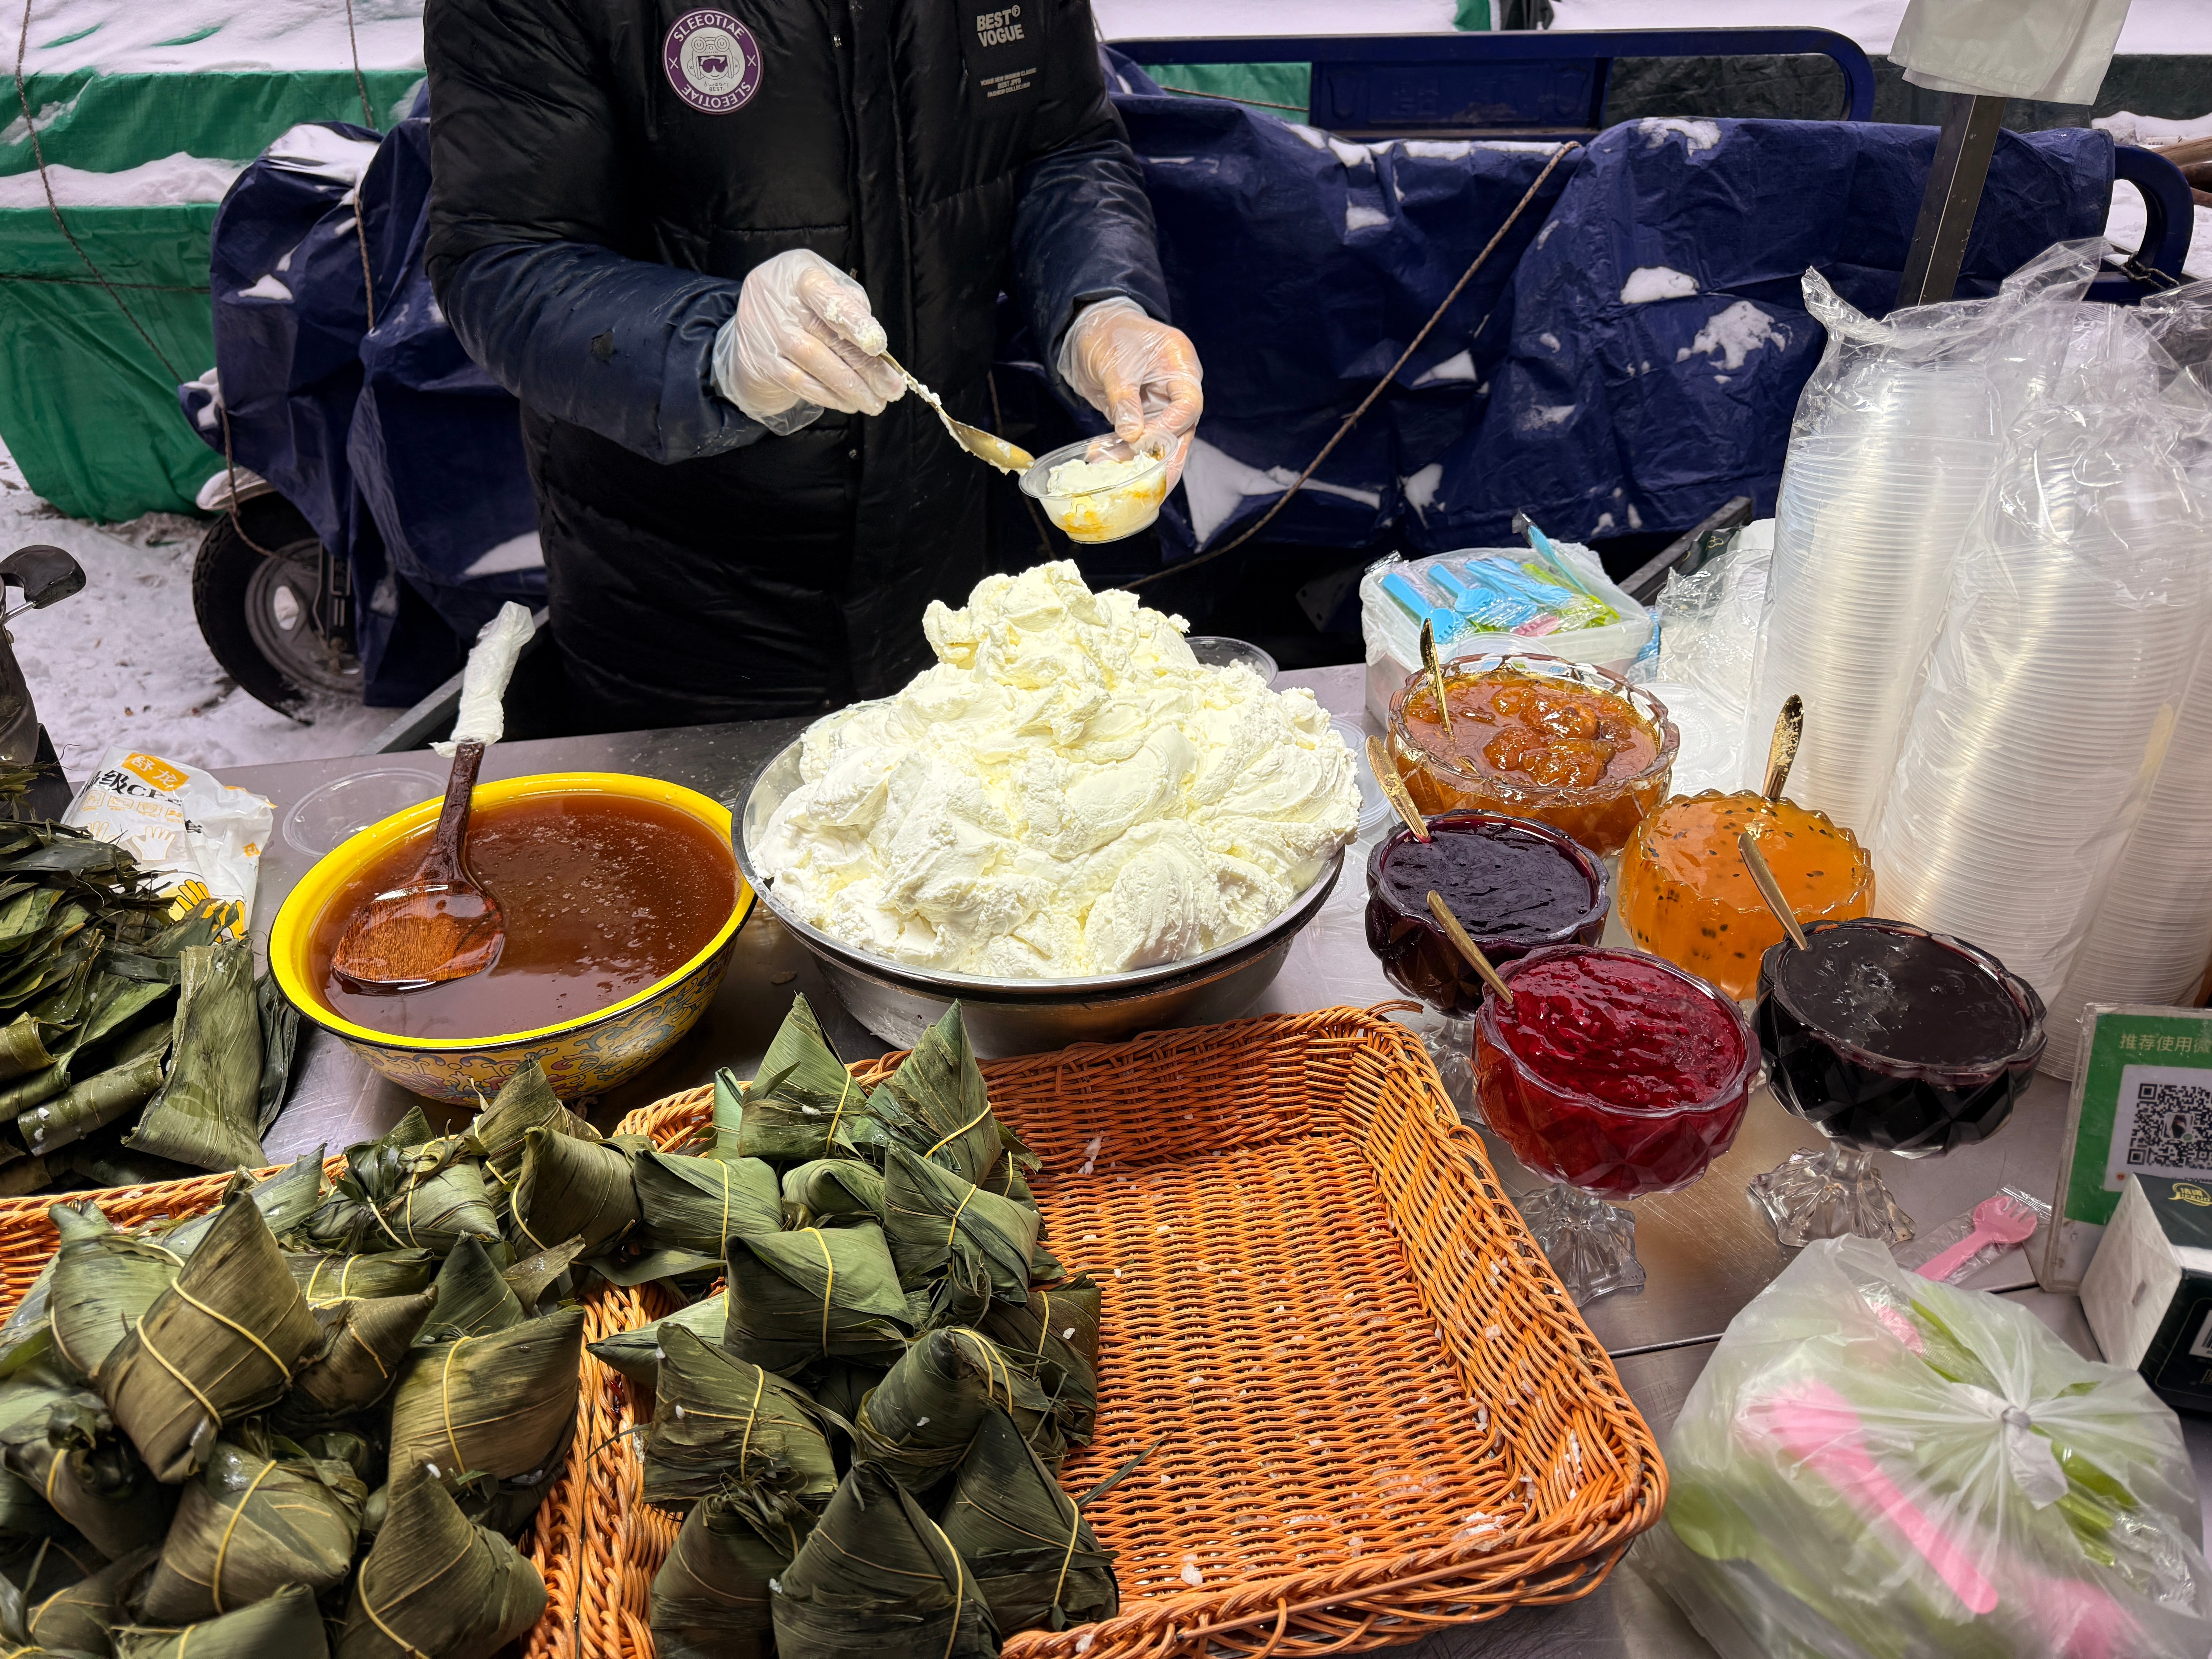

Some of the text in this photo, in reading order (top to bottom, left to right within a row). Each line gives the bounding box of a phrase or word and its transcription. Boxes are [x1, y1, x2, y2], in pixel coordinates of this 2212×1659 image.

[674, 14, 744, 41] SLEEOTIAE
[977, 9, 1011, 31] BEST
[978, 24, 1025, 47] VOGUE
[681, 82, 751, 108] SLEEOTIAE
[131, 756, 177, 788] 舒龙
